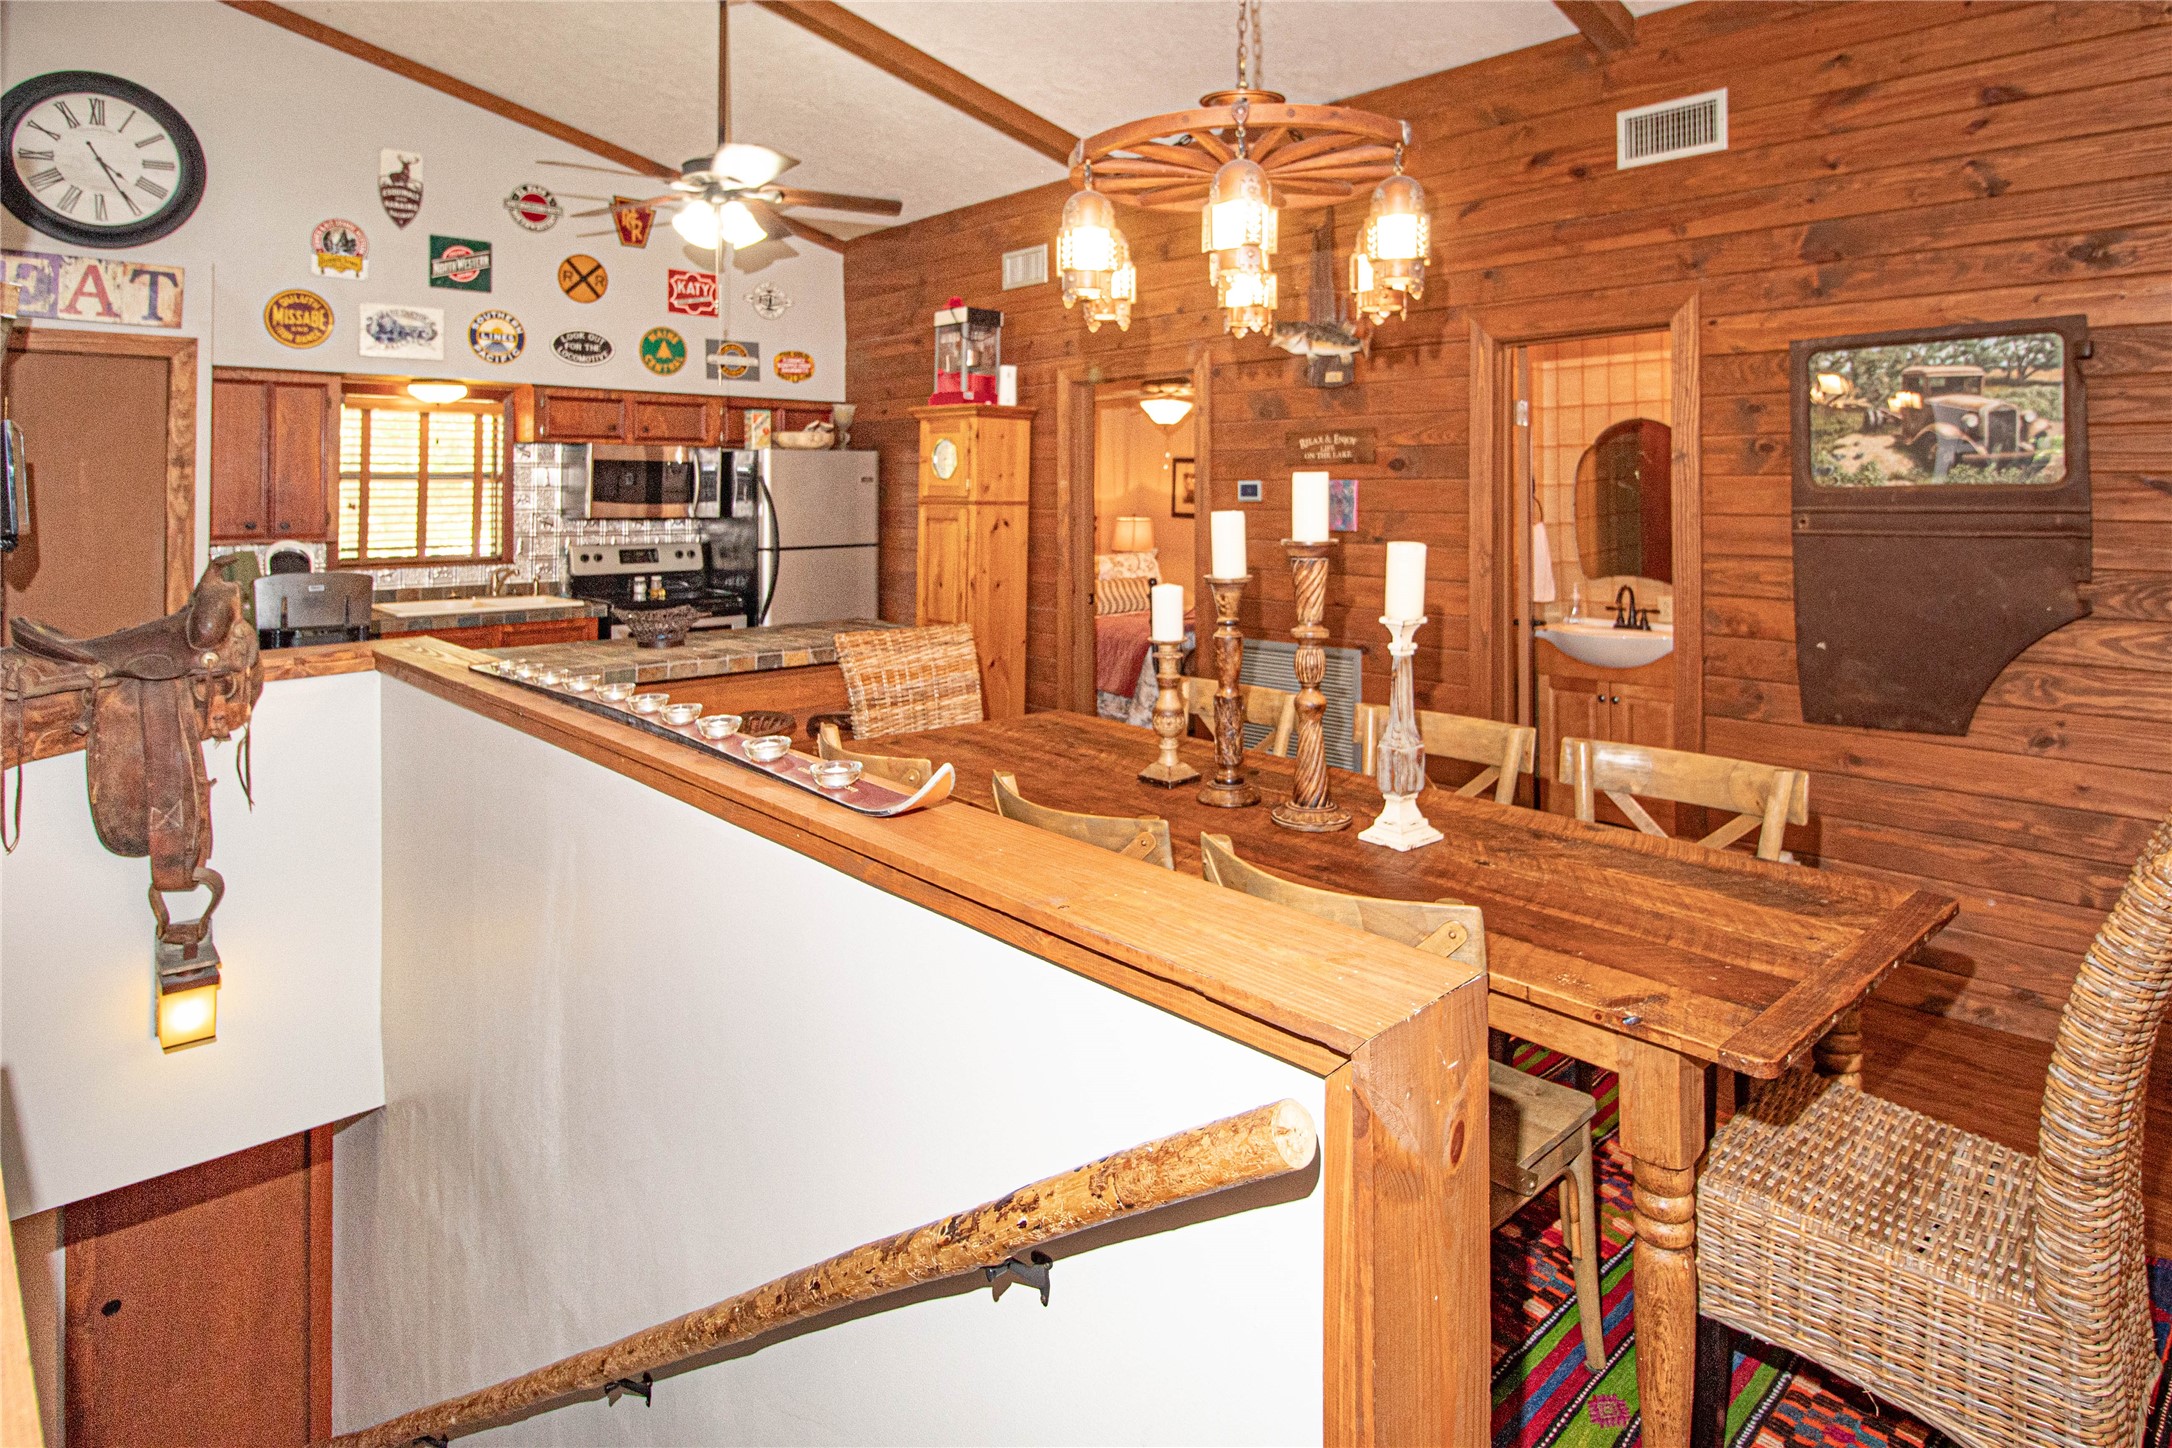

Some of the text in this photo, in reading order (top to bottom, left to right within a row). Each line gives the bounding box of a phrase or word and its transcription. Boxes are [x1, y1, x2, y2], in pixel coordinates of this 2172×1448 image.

[88, 98, 105, 126] XII
[562, 270, 605, 287] R R
[5, 256, 179, 322] EAT
[676, 280, 711, 297] KATY
[278, 293, 322, 308] DULUTH
[271, 304, 327, 330] MISSABE
[472, 312, 523, 335] SOUTHERN
[480, 333, 515, 341] LINES
[560, 332, 606, 345] LOOK OUT
[474, 344, 520, 363] PACIFIC
[557, 346, 609, 363] LOCOMOTIVE
[564, 342, 601, 352] FOR THE
[1299, 435, 1324, 449] RELAX
[1325, 434, 1332, 444] &
[1333, 450, 1353, 459] LAKE
